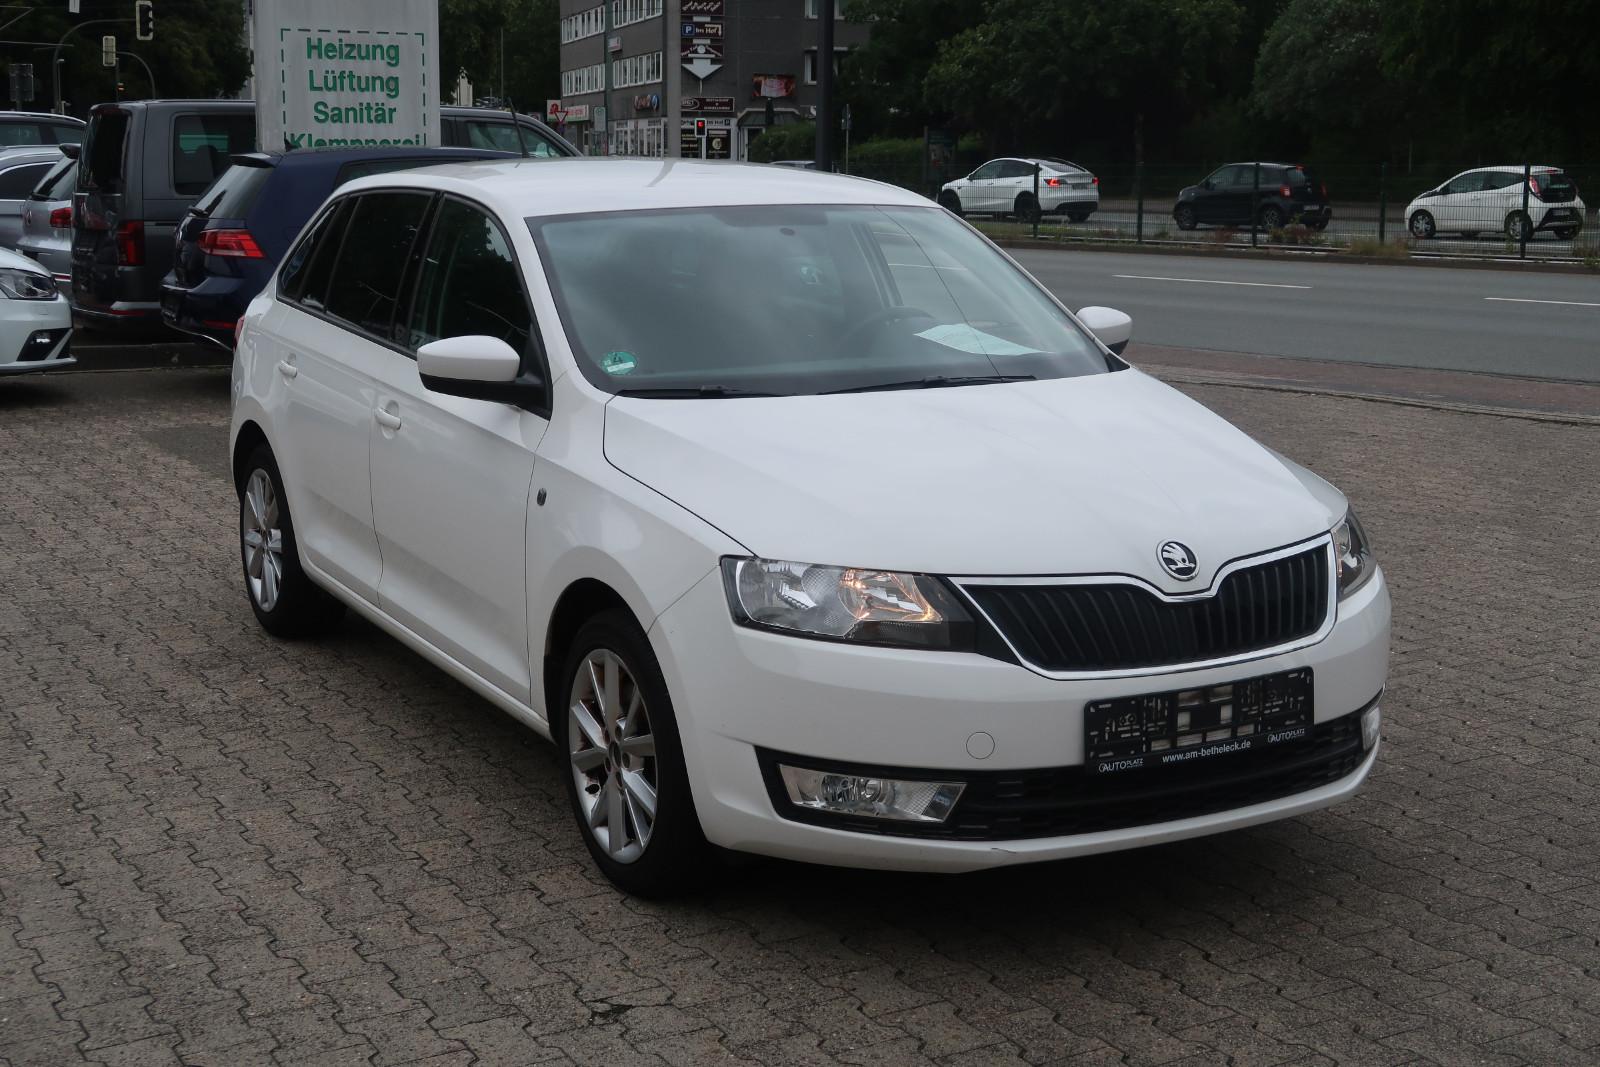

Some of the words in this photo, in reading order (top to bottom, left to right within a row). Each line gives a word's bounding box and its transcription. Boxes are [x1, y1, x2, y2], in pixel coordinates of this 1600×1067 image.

[306, 37, 400, 67] Heizung
[308, 69, 400, 99] Lüftung
[313, 100, 397, 124] Sanitär
[1162, 739, 1252, 763] www.am-betheleck.de
